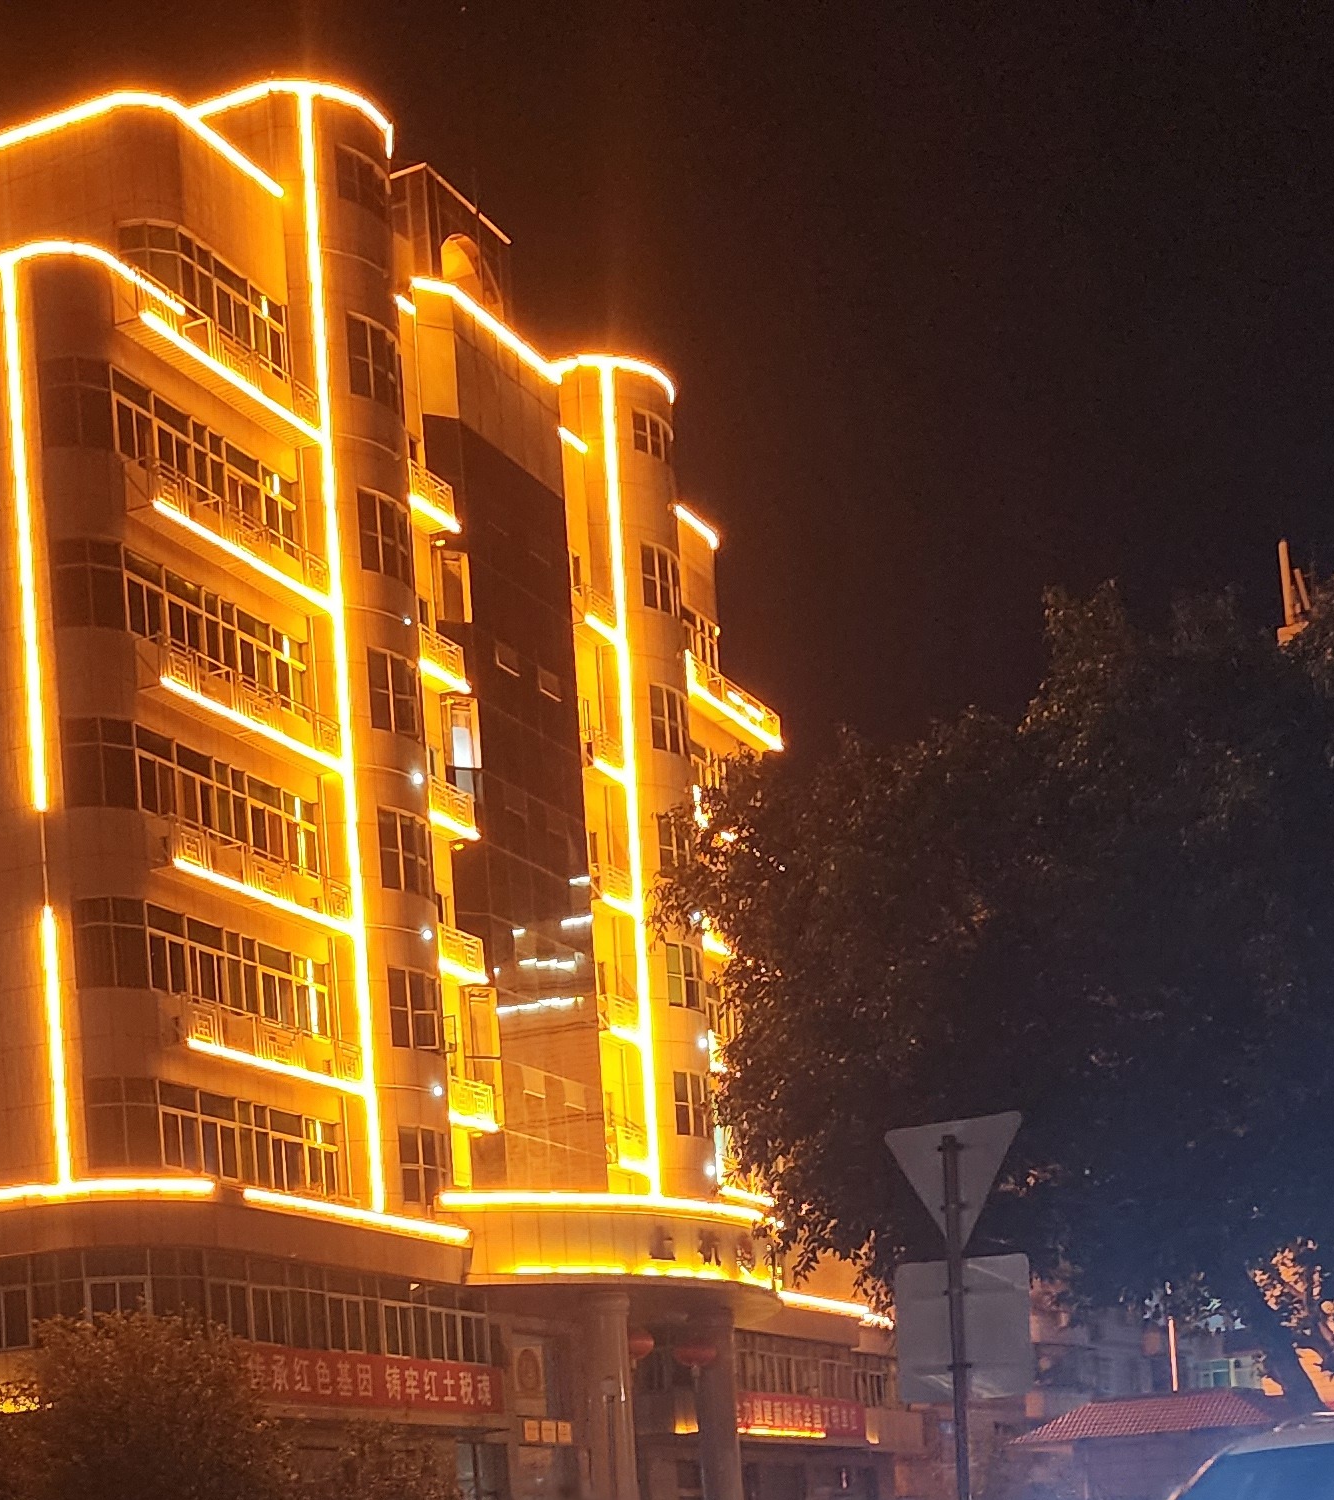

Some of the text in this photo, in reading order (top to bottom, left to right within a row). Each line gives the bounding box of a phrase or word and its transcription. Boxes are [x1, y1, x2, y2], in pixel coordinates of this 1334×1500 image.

[385, 1363, 493, 1406] 铸牢红土税魂
